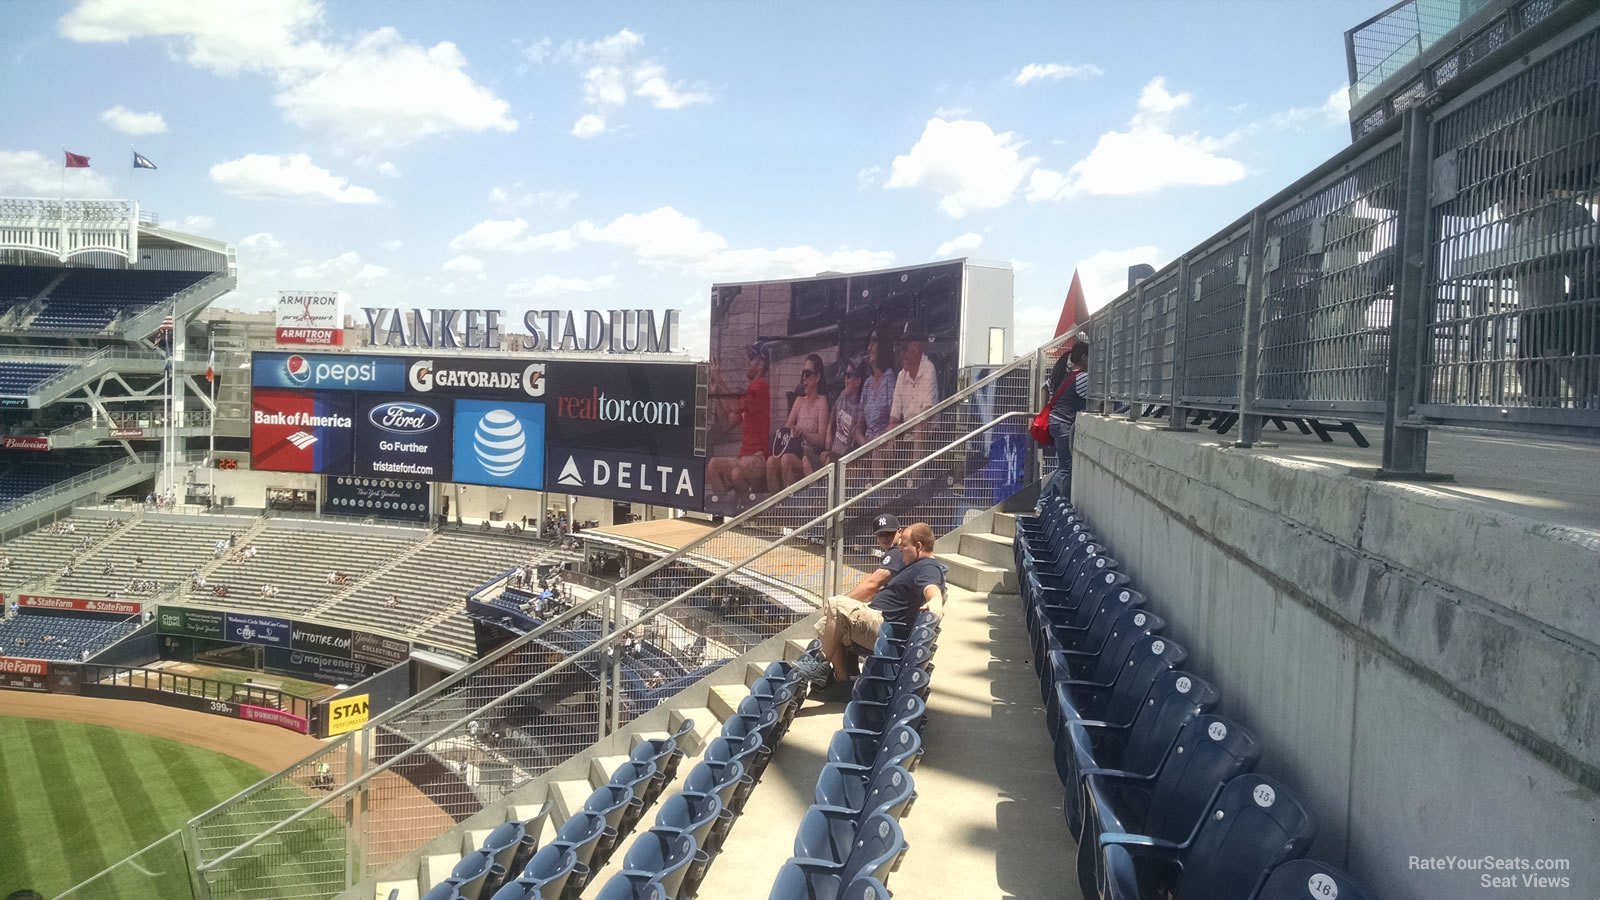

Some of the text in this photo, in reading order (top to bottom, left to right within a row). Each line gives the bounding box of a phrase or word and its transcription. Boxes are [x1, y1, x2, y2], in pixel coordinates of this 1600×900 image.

[279, 296, 336, 305] ARMITRON
[281, 330, 333, 339] ARMITRON
[361, 308, 674, 353] YANKEE STADIUM
[315, 361, 376, 385] pepsi
[409, 360, 546, 397] G GATORADE G
[558, 386, 680, 426] realtor.com
[254, 410, 352, 428] Bank of America
[382, 406, 426, 428] Ford
[4, 438, 48, 448] Budweiser
[379, 441, 428, 453] Go Further
[372, 461, 434, 475] tristateford.com
[593, 459, 695, 497] DELTA
[292, 629, 351, 650] NITTOTIRE.COM
[1211, 726, 1223, 737] 14
[1258, 789, 1270, 802] 15
[1314, 880, 1332, 896] 16
